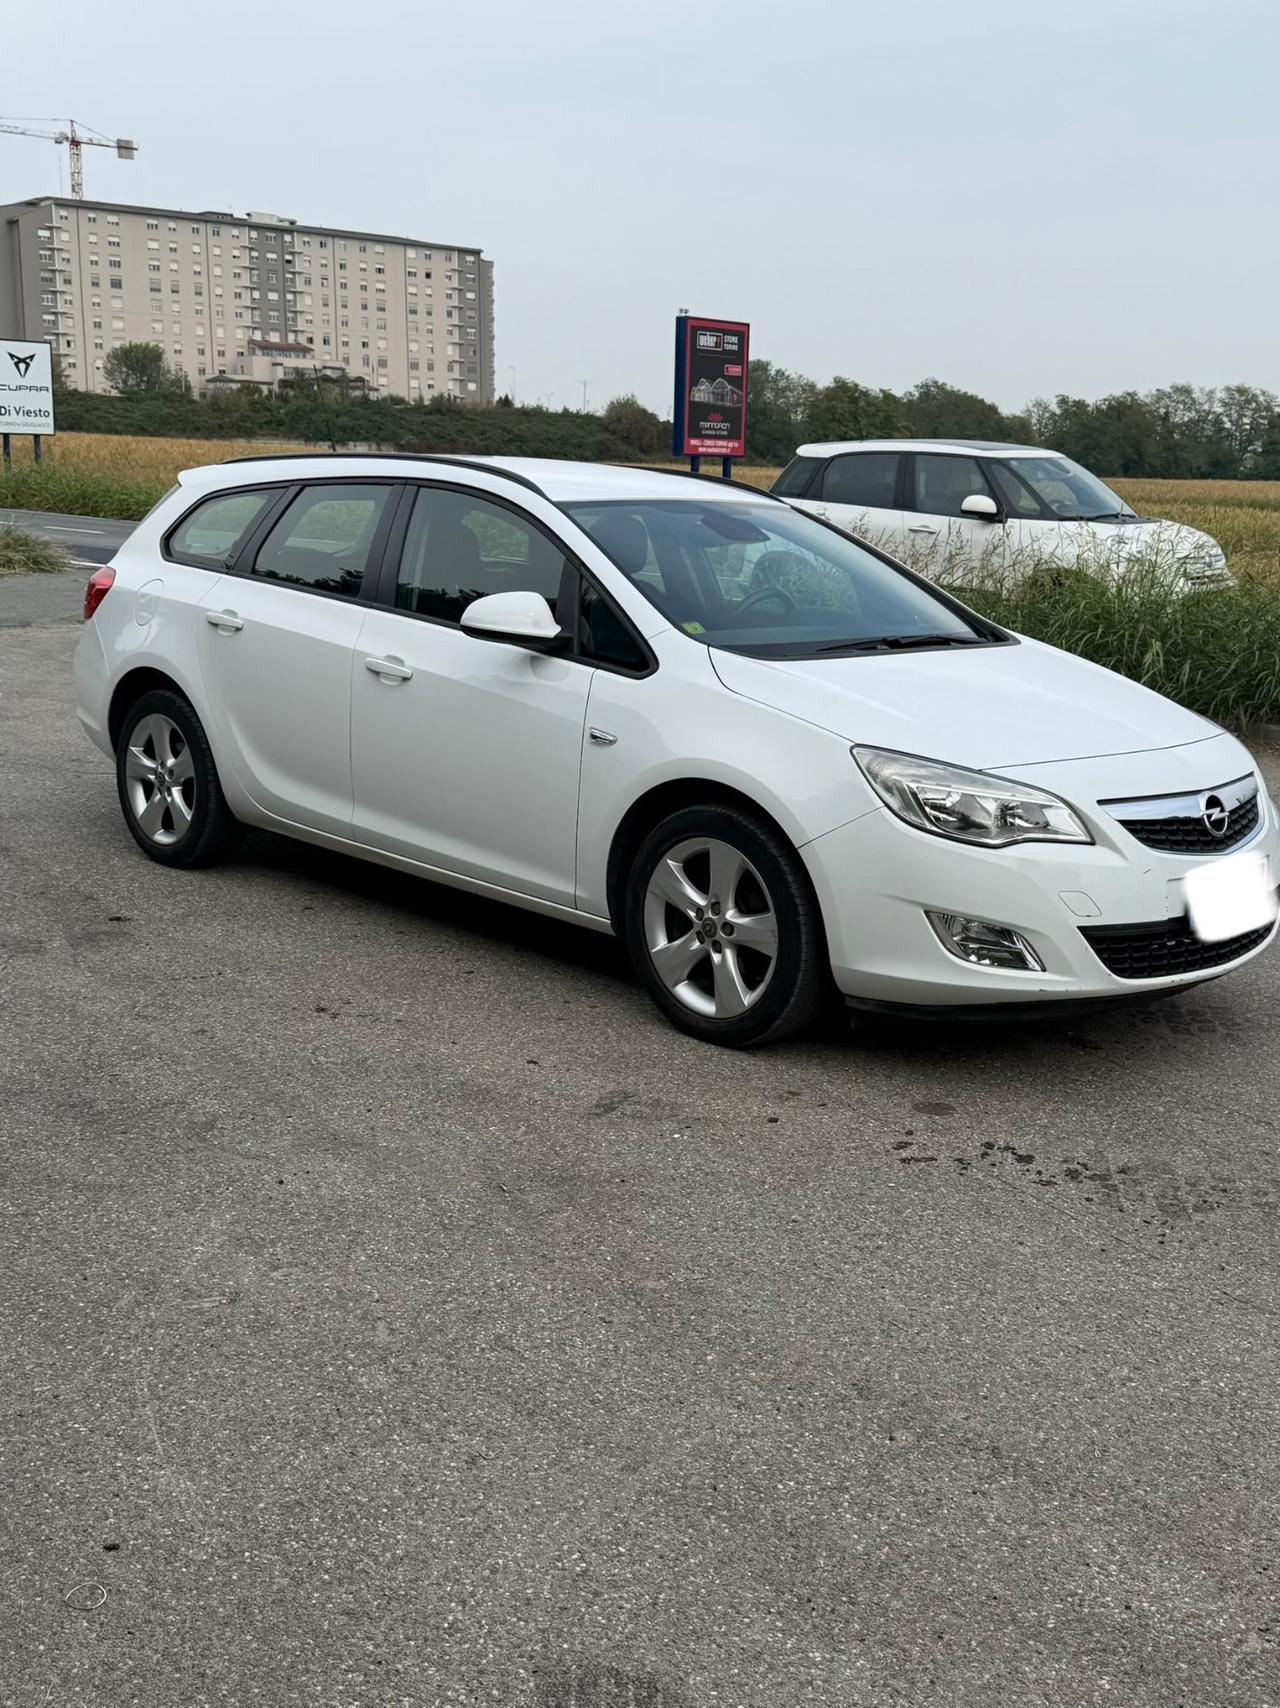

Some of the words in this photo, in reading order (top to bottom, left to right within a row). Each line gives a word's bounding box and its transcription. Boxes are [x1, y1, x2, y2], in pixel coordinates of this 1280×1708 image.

[0, 384, 49, 392] CUPRA
[0, 405, 11, 417] Di
[13, 405, 50, 418] Viesto
